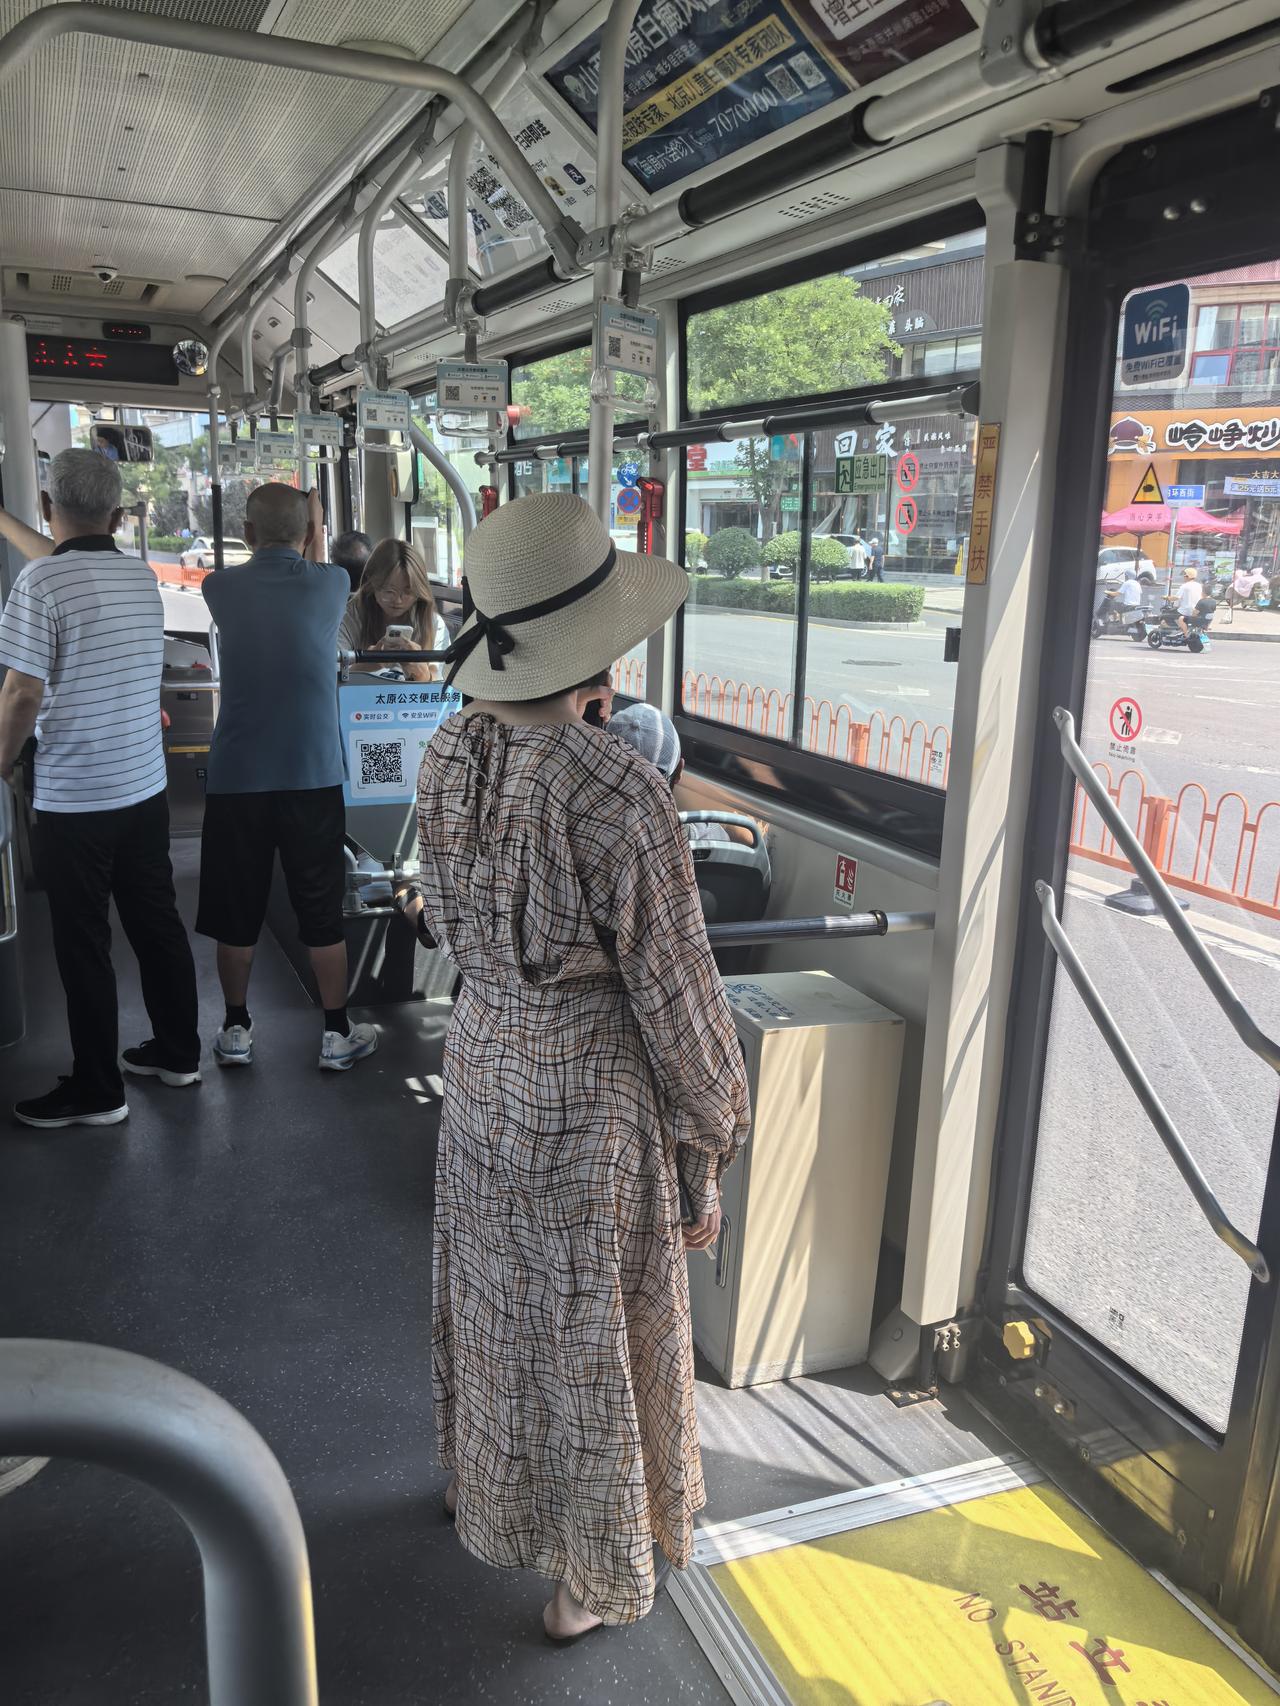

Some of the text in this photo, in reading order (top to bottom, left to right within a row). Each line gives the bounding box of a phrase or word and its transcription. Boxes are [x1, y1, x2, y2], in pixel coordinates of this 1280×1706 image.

[707, 87, 778, 137] 7070000
[1134, 315, 1178, 345] WiFi
[854, 453, 887, 480] 应急出口
[970, 436, 996, 571] 严禁手扶
[953, 1592, 998, 1623] NO
